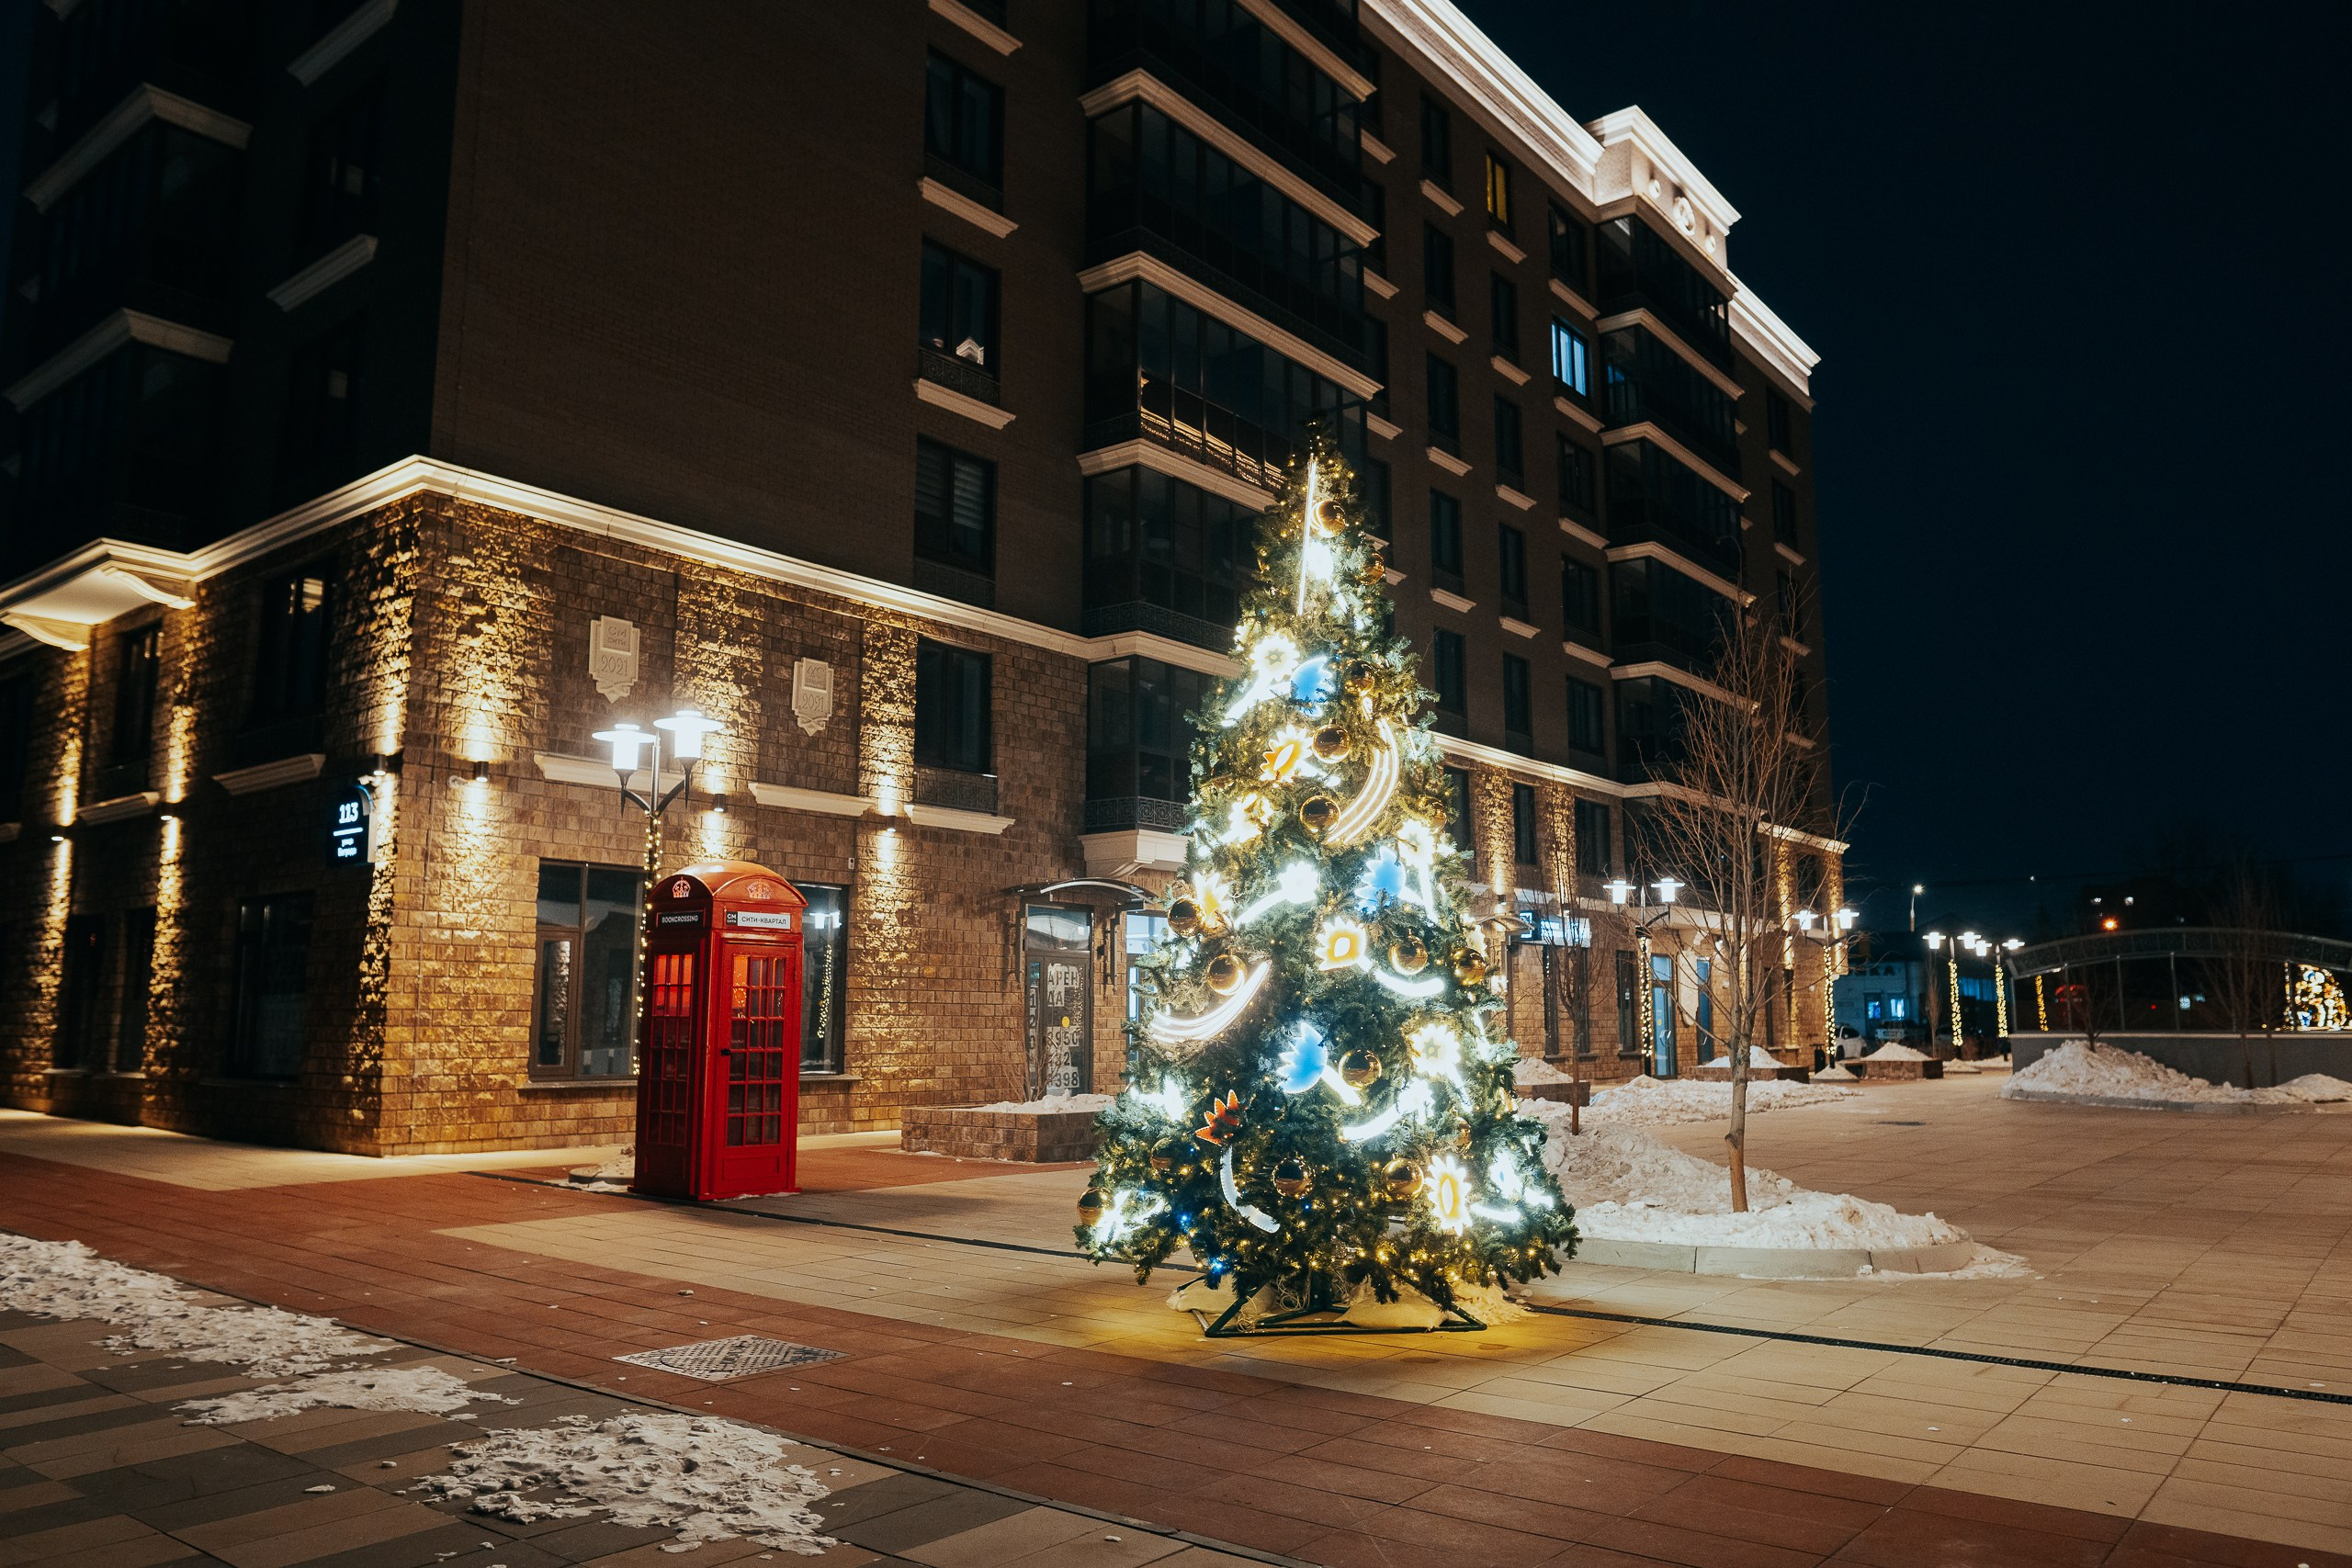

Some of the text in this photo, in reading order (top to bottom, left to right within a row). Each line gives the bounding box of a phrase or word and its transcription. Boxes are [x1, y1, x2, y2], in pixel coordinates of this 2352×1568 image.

[601, 654, 628, 677] 2021
[802, 693, 824, 713] 2021
[339, 802, 359, 824] 113
[662, 915, 698, 924] BOOKCROSSING
[741, 916, 786, 925] СИТИ-КВАРТАЛ
[1048, 970, 1078, 986] АРЕН
[1047, 990, 1064, 1005] ДА
